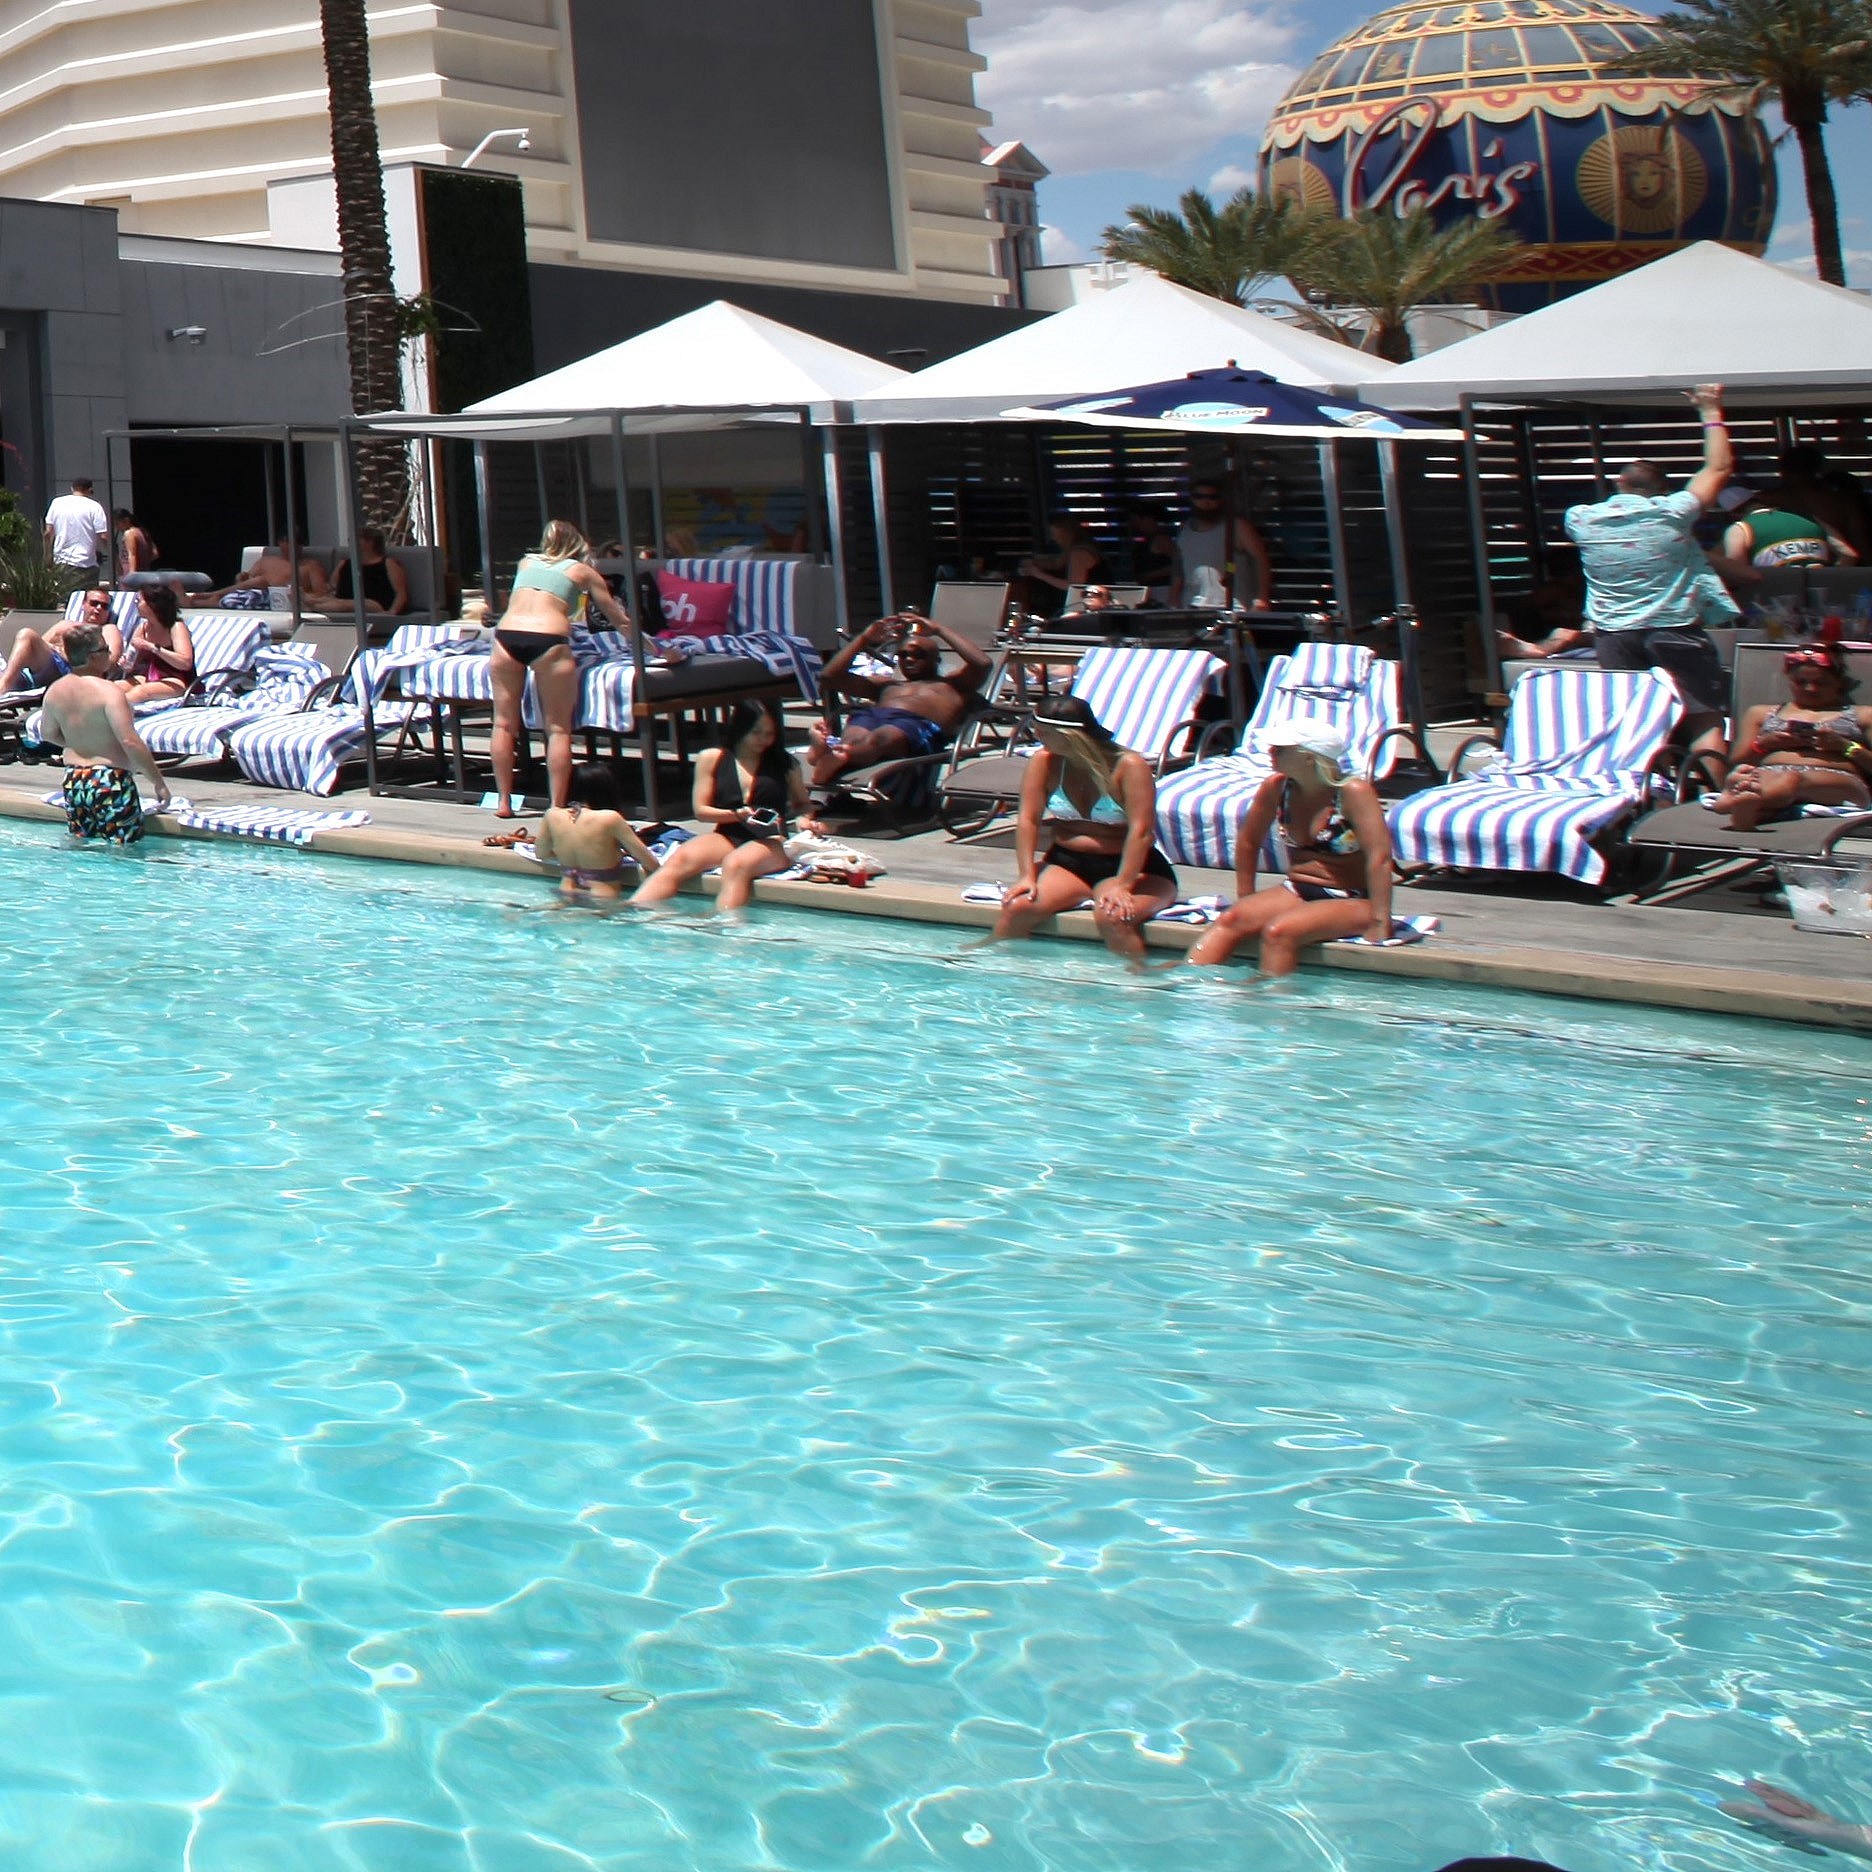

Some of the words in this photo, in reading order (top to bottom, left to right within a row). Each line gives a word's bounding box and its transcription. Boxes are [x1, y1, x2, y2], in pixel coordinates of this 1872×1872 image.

[1344, 95, 1539, 221] Paris
[1216, 408, 1264, 417] MOON
[1770, 541, 1820, 559] KEMP
